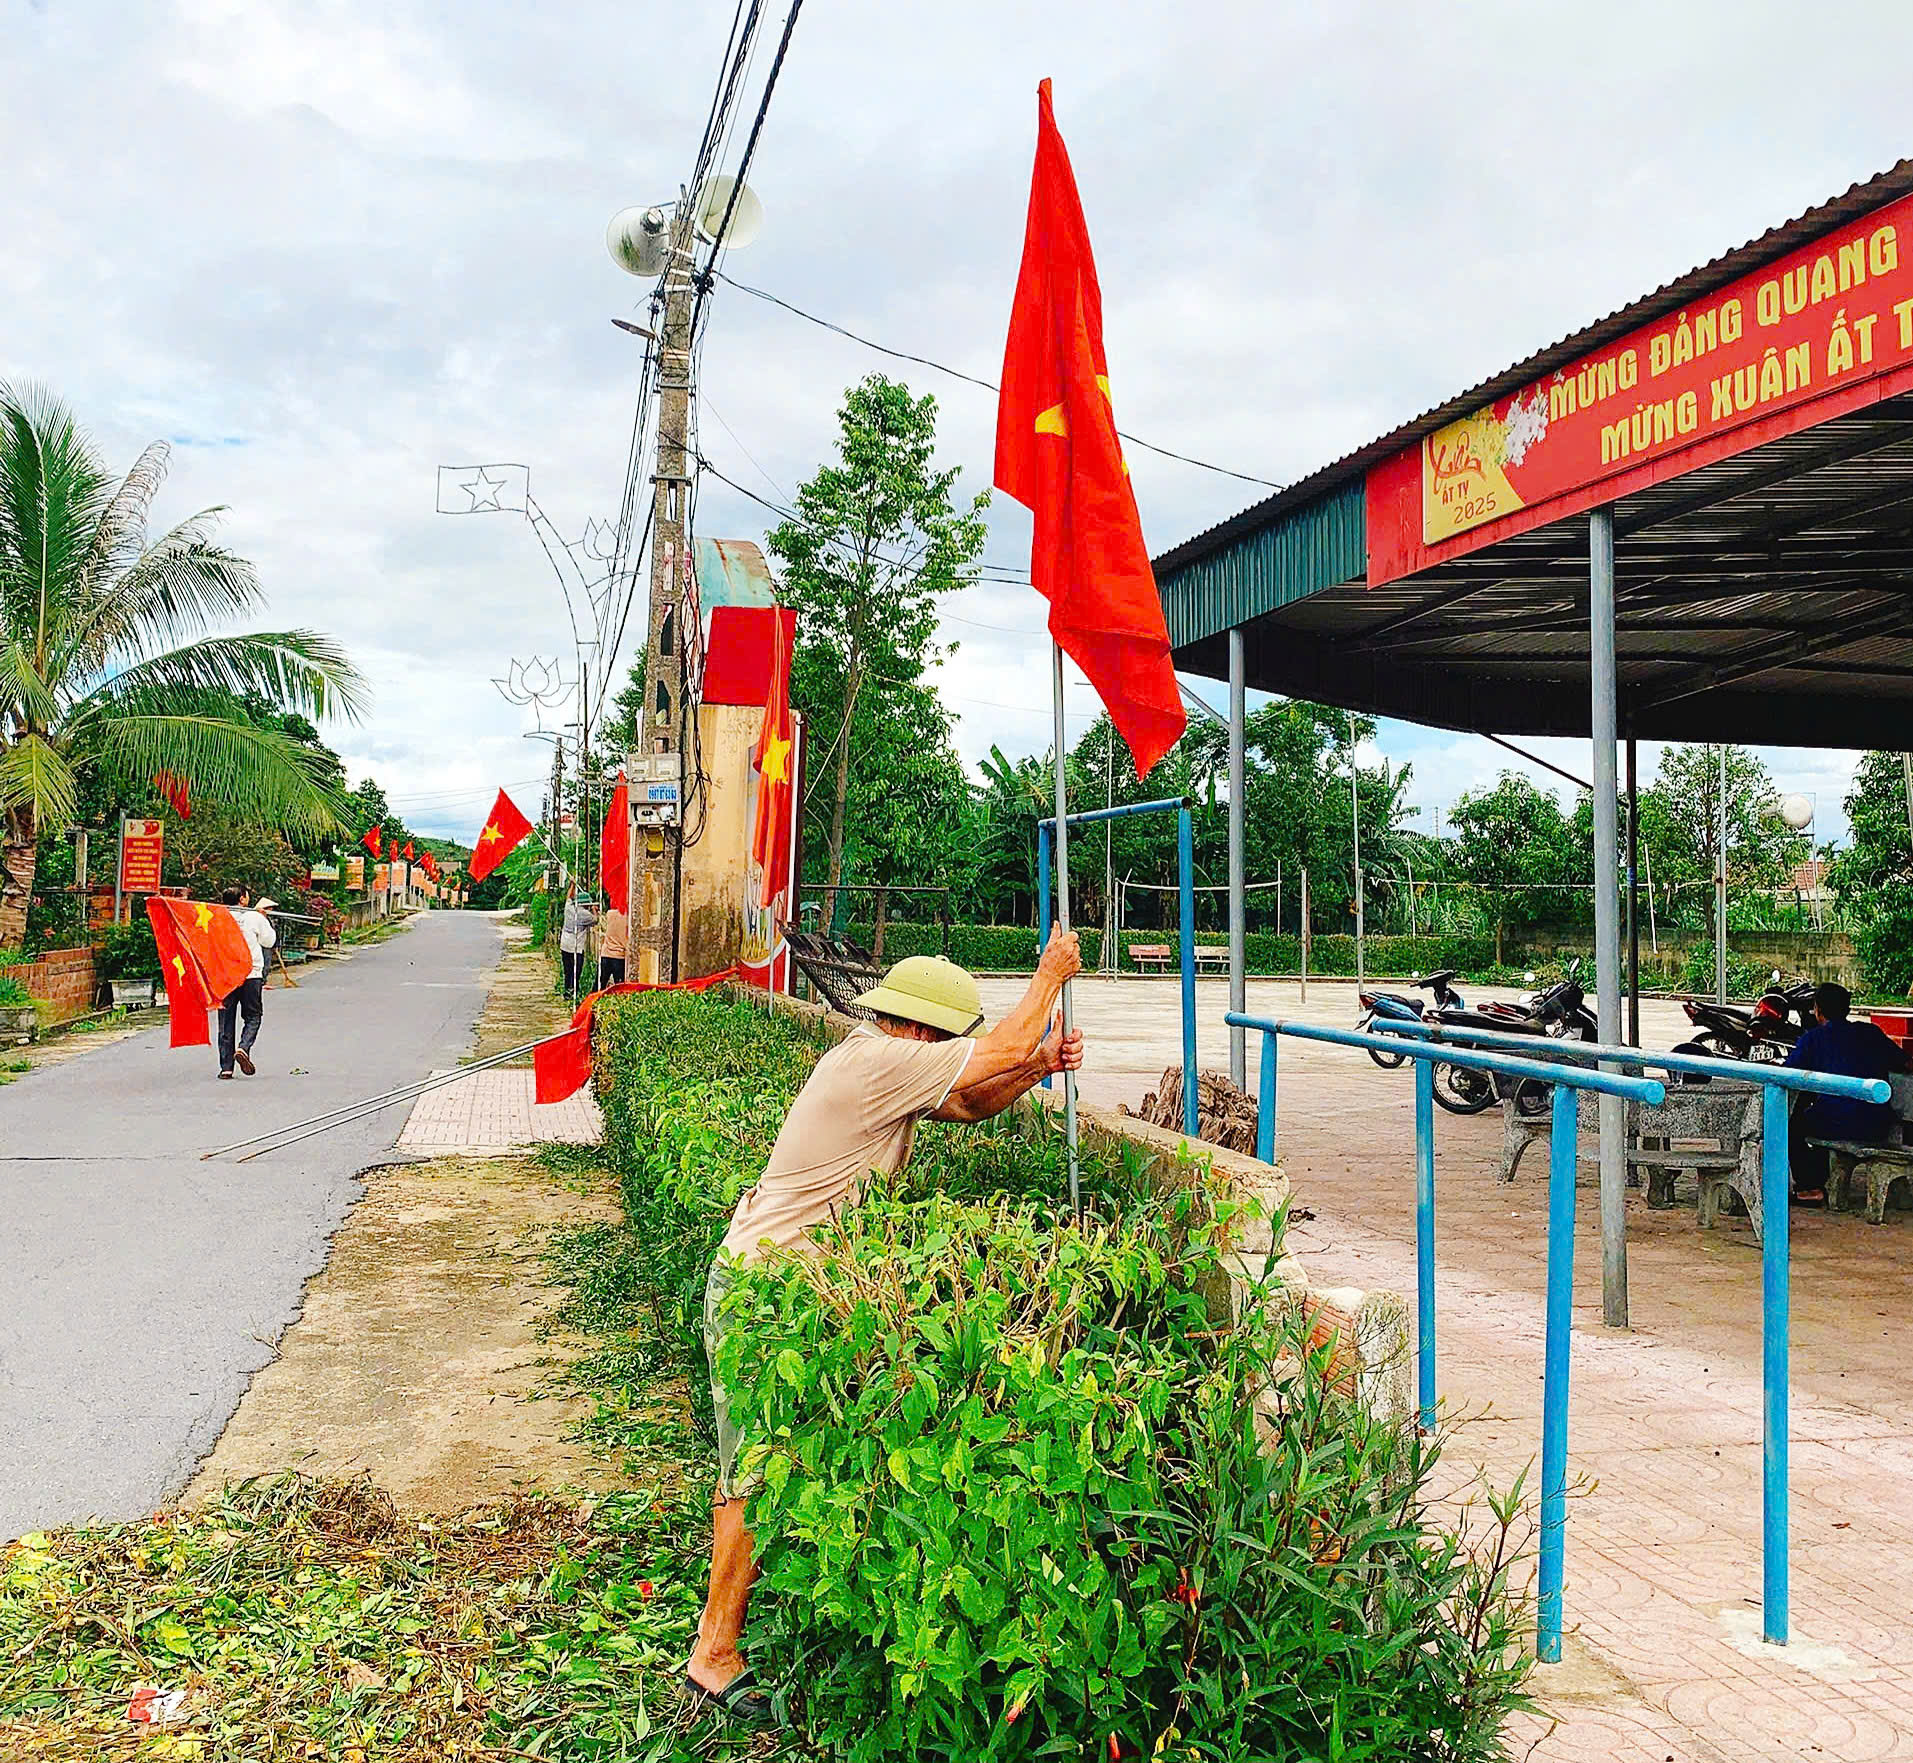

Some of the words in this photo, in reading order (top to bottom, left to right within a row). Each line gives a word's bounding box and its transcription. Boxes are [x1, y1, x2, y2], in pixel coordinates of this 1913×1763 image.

[1550, 349, 1638, 423] MỪNG
[1649, 299, 1742, 378] ĐẢNG
[1756, 225, 1898, 327] QUANG
[1601, 391, 1698, 465] MỪNG
[1710, 341, 1811, 422] XUÂN
[1827, 308, 1878, 377] ẤT
[1454, 491, 1497, 524] 2025
